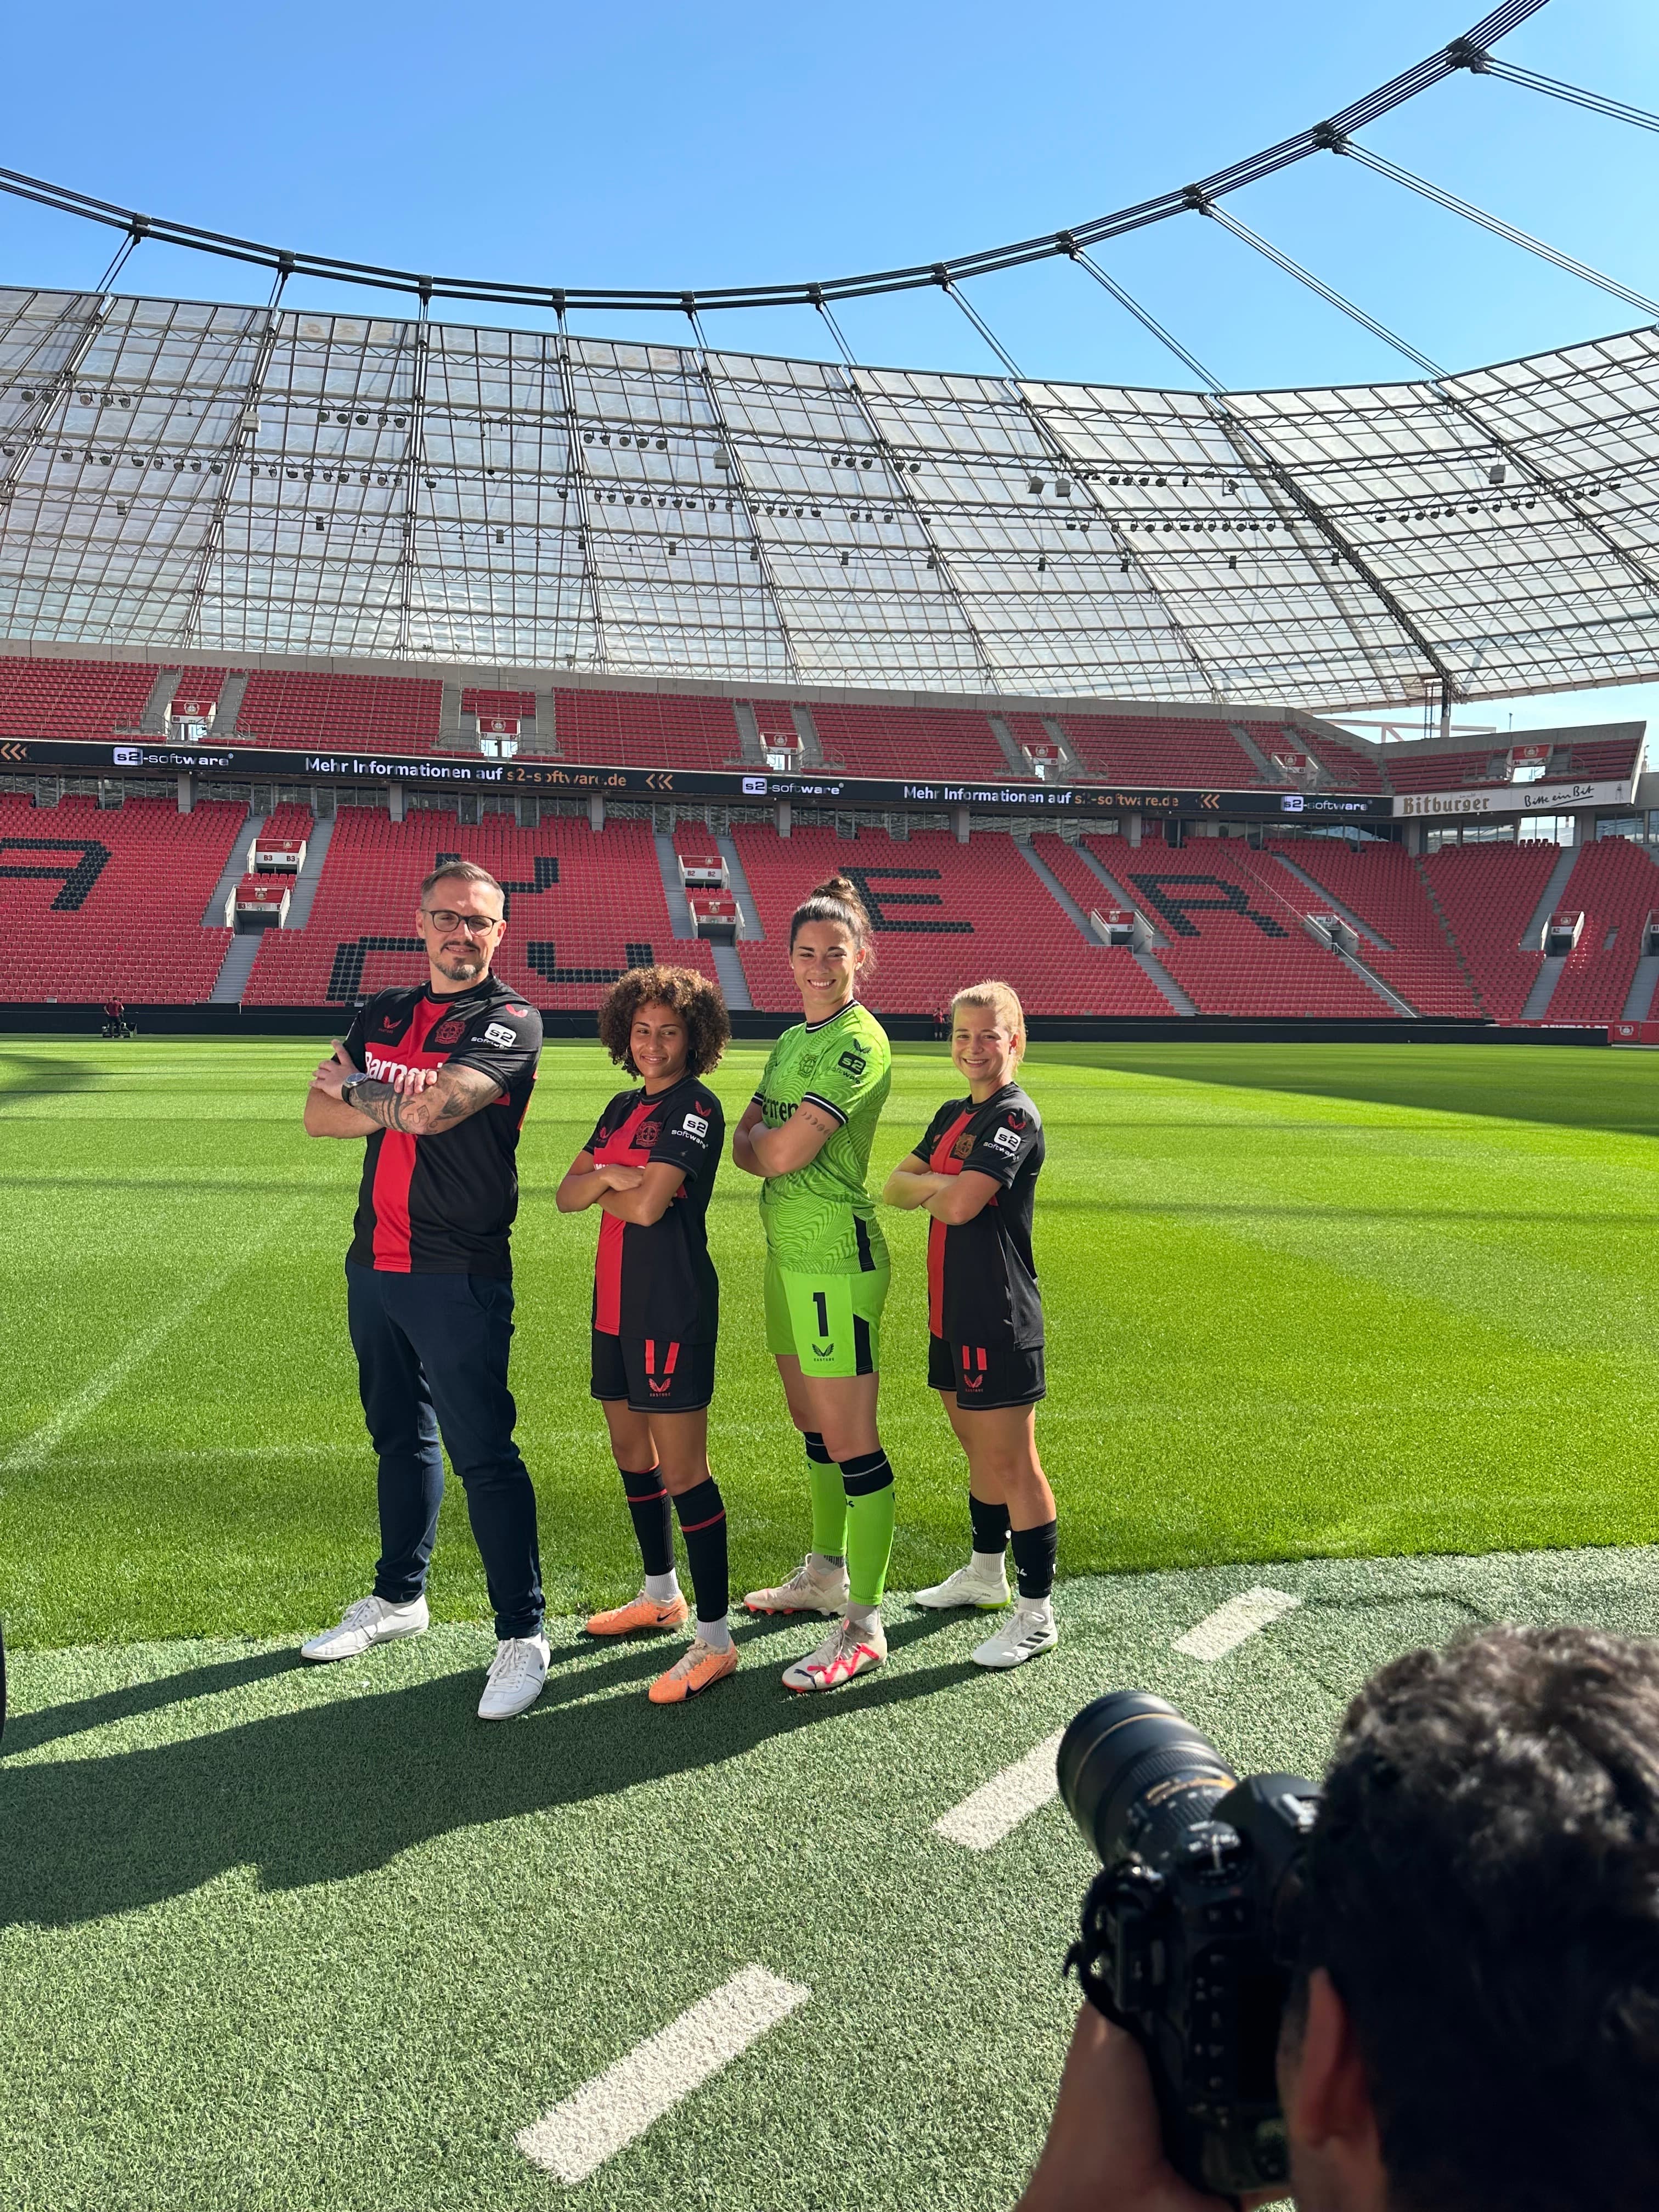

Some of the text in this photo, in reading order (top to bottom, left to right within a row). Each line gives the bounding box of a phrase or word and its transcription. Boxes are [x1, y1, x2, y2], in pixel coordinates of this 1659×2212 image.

[305, 757, 348, 772] Mehr
[353, 759, 471, 778] Informationen
[476, 767, 503, 780] auf
[904, 786, 940, 799] Mehr
[944, 787, 1043, 803] Informationen
[1048, 792, 1071, 804] auf
[1524, 785, 1595, 808] Bitte ein Bit
[1402, 795, 1490, 815] Bitburger
[489, 1029, 514, 1043] s2
[842, 1057, 864, 1072] s2
[687, 1120, 706, 1134] s2
[998, 1133, 1019, 1148] s2
[812, 1291, 829, 1337] 1
